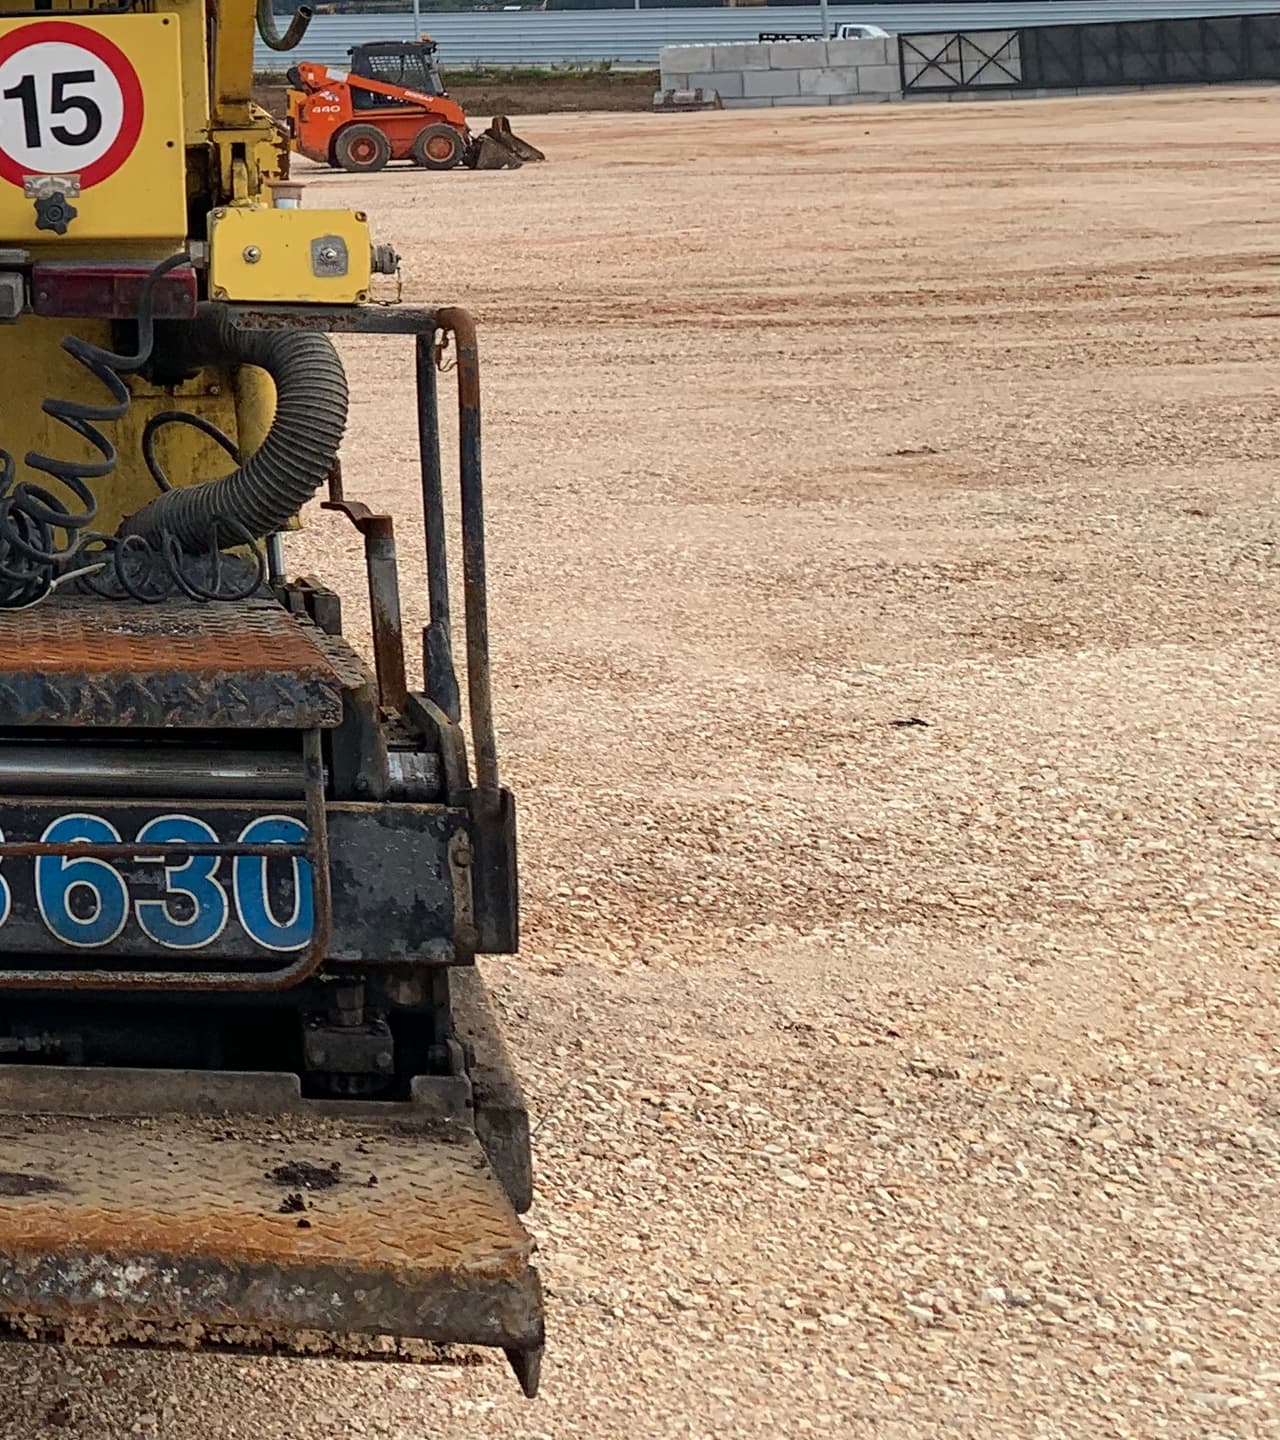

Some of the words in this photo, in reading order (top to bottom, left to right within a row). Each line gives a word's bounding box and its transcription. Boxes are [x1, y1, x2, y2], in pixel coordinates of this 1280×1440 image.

[3, 69, 102, 148] 15
[312, 105, 341, 113] 440
[35, 812, 313, 952] 630
